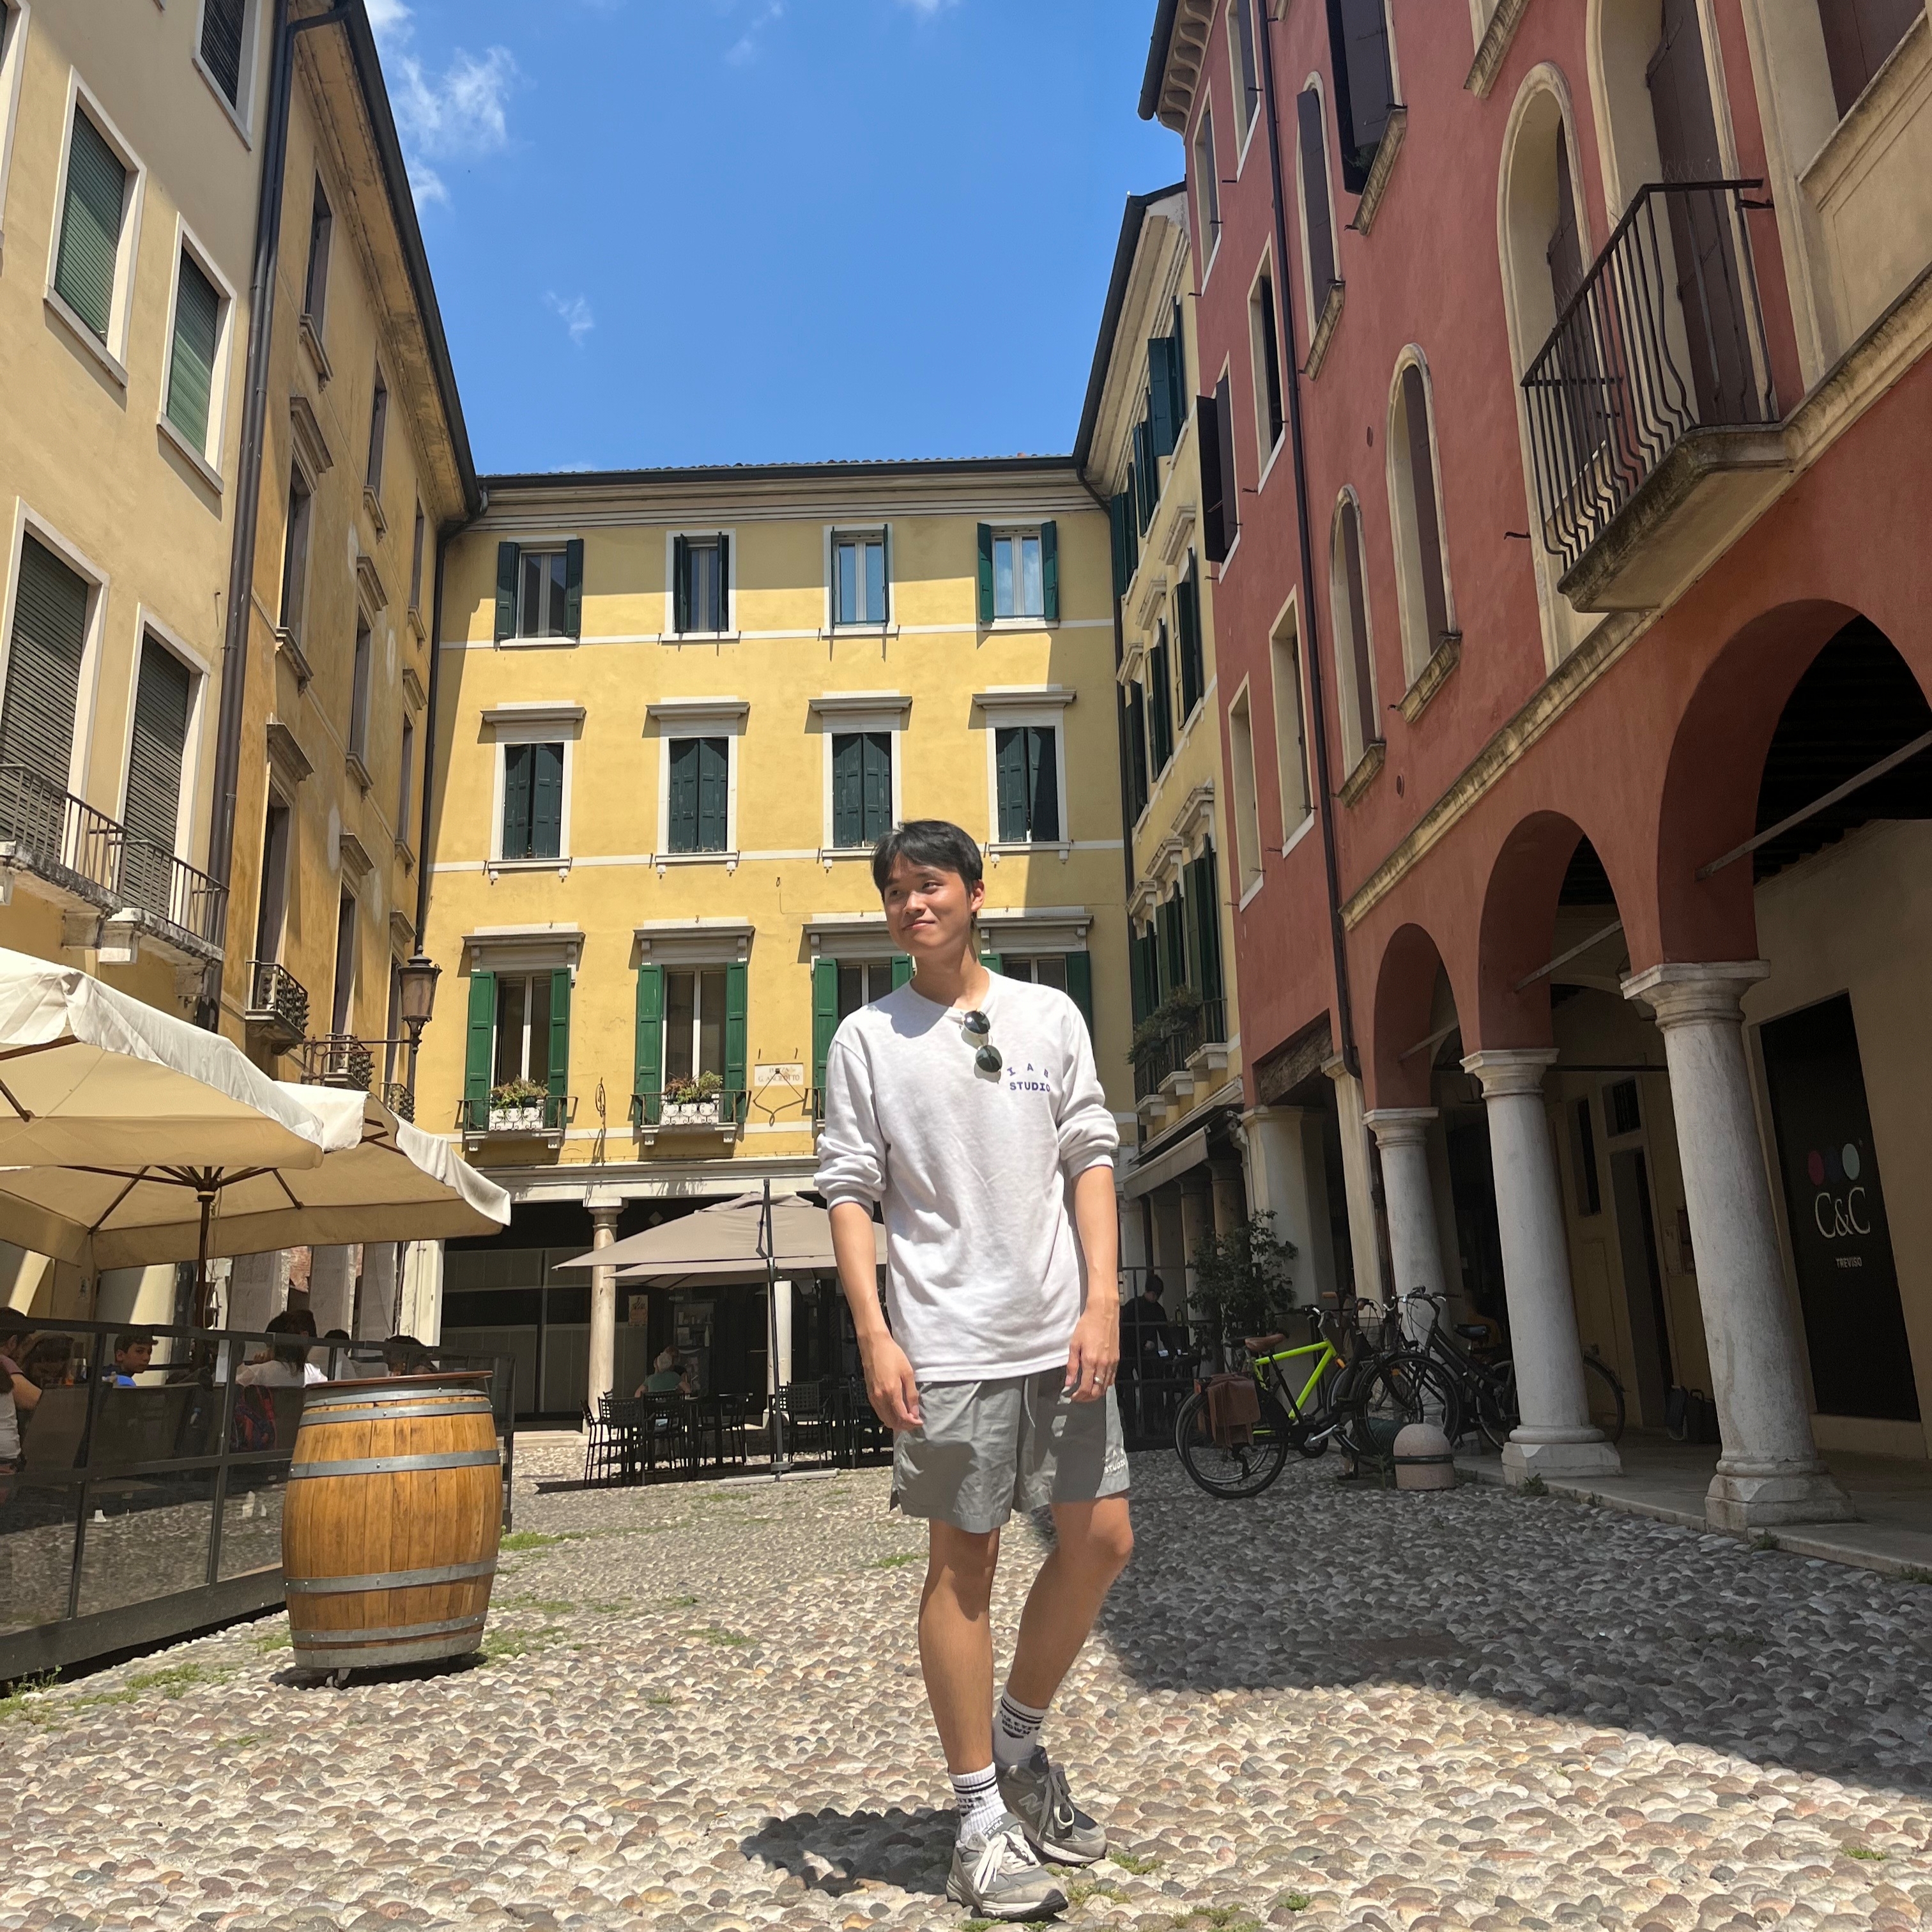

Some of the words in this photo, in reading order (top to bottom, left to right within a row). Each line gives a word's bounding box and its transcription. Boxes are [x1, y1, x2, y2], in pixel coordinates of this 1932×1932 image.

[1009, 1082, 1050, 1092] STUDIO
[1814, 1186, 1871, 1238] C&C
[1835, 1257, 1862, 1268] TREVISO
